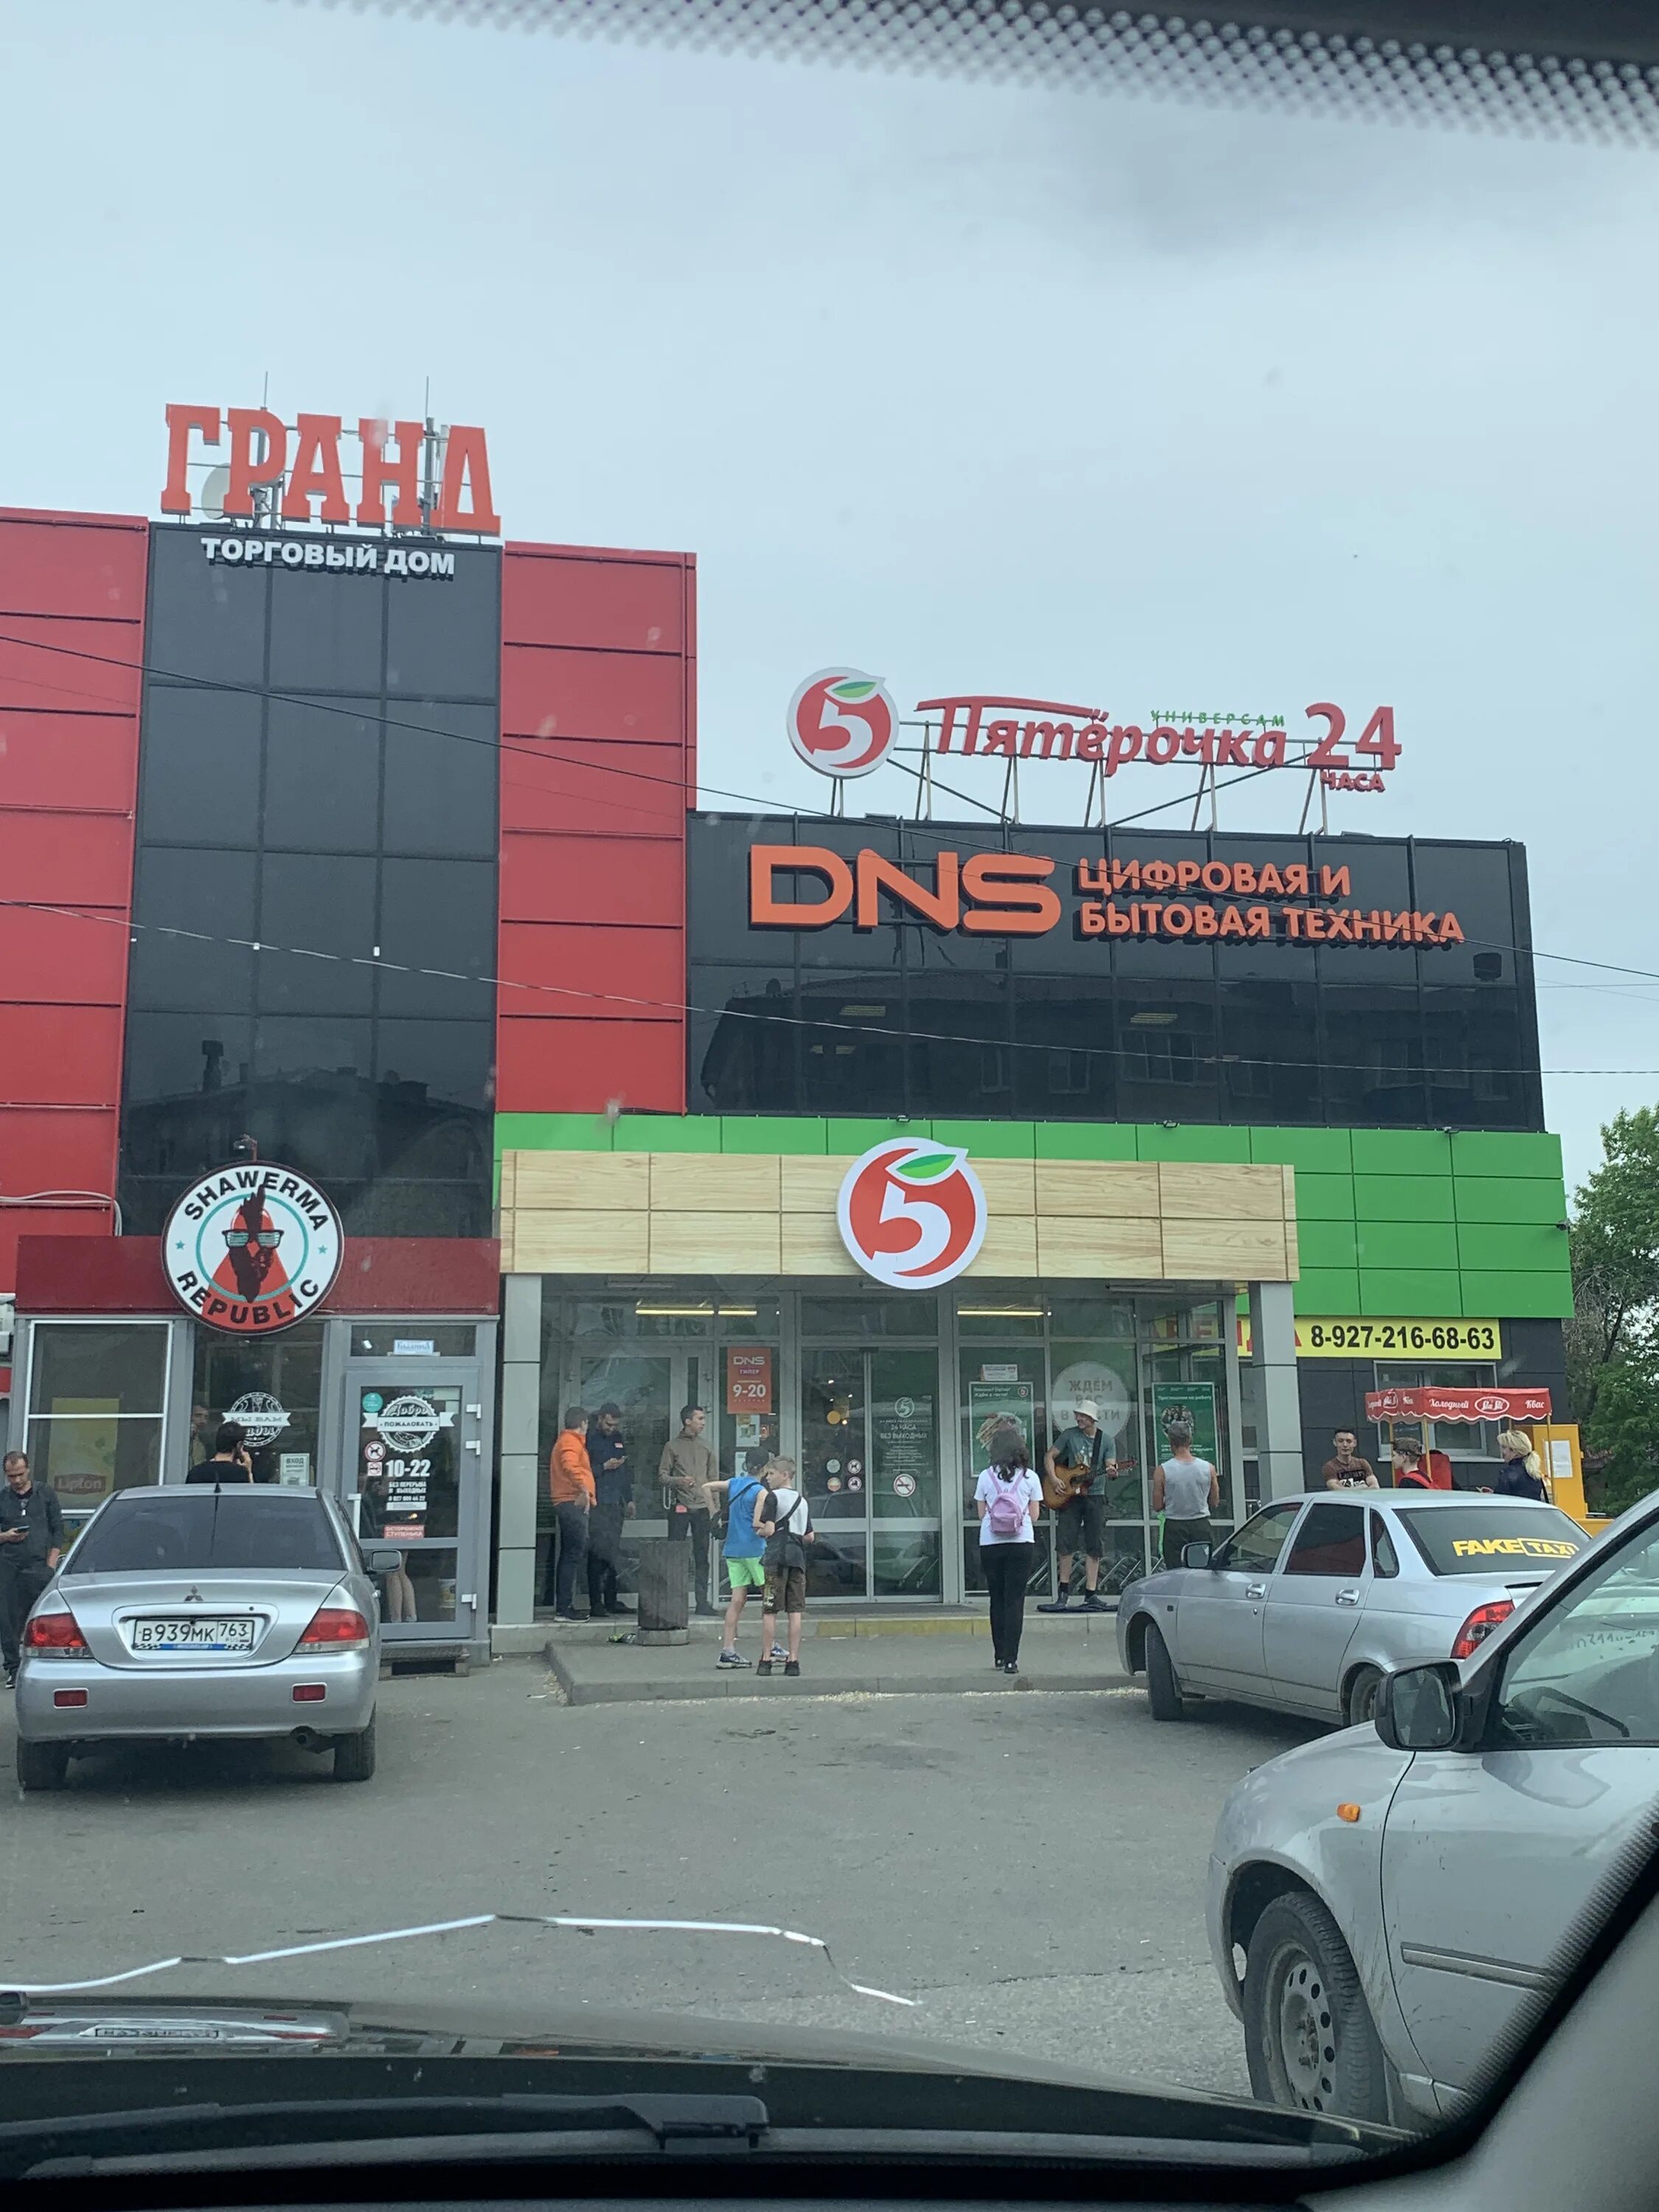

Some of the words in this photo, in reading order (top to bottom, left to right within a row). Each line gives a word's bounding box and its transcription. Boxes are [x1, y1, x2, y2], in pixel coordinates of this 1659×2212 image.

[161, 403, 501, 537] ГРАНД
[201, 538, 378, 570] ТОРГОВЫЙ
[384, 549, 454, 574] ДОМ
[1151, 709, 1284, 727] УНИВЕРСАМ
[914, 696, 1287, 777] Пятёрочка
[1304, 702, 1402, 771] 24
[1320, 771, 1385, 793] ЧАСА
[751, 844, 1061, 933] DNS
[1078, 858, 1308, 897] ЦИФРОВАЯ
[1321, 865, 1351, 897] И
[1080, 902, 1270, 938] БЫТОВАЯ
[1282, 907, 1465, 944] ТЕХНИКА
[184, 1171, 329, 1231] SHAWERMA
[177, 1270, 319, 1324] REPUBLIC
[1311, 1325, 1495, 1349] 8-927-216-68-63
[733, 1356, 765, 1365] DNS
[733, 1384, 767, 1398] 9-20
[390, 1404, 428, 1417] Добро
[1061, 1410, 1068, 1420] В
[1429, 1398, 1470, 1410] Холодный
[1525, 1399, 1545, 1409] Квас
[385, 1459, 431, 1477] 10-22
[1453, 1539, 1525, 1557] FAKE
[1527, 1542, 1576, 1555] TAXI
[220, 1623, 248, 1637] 763
